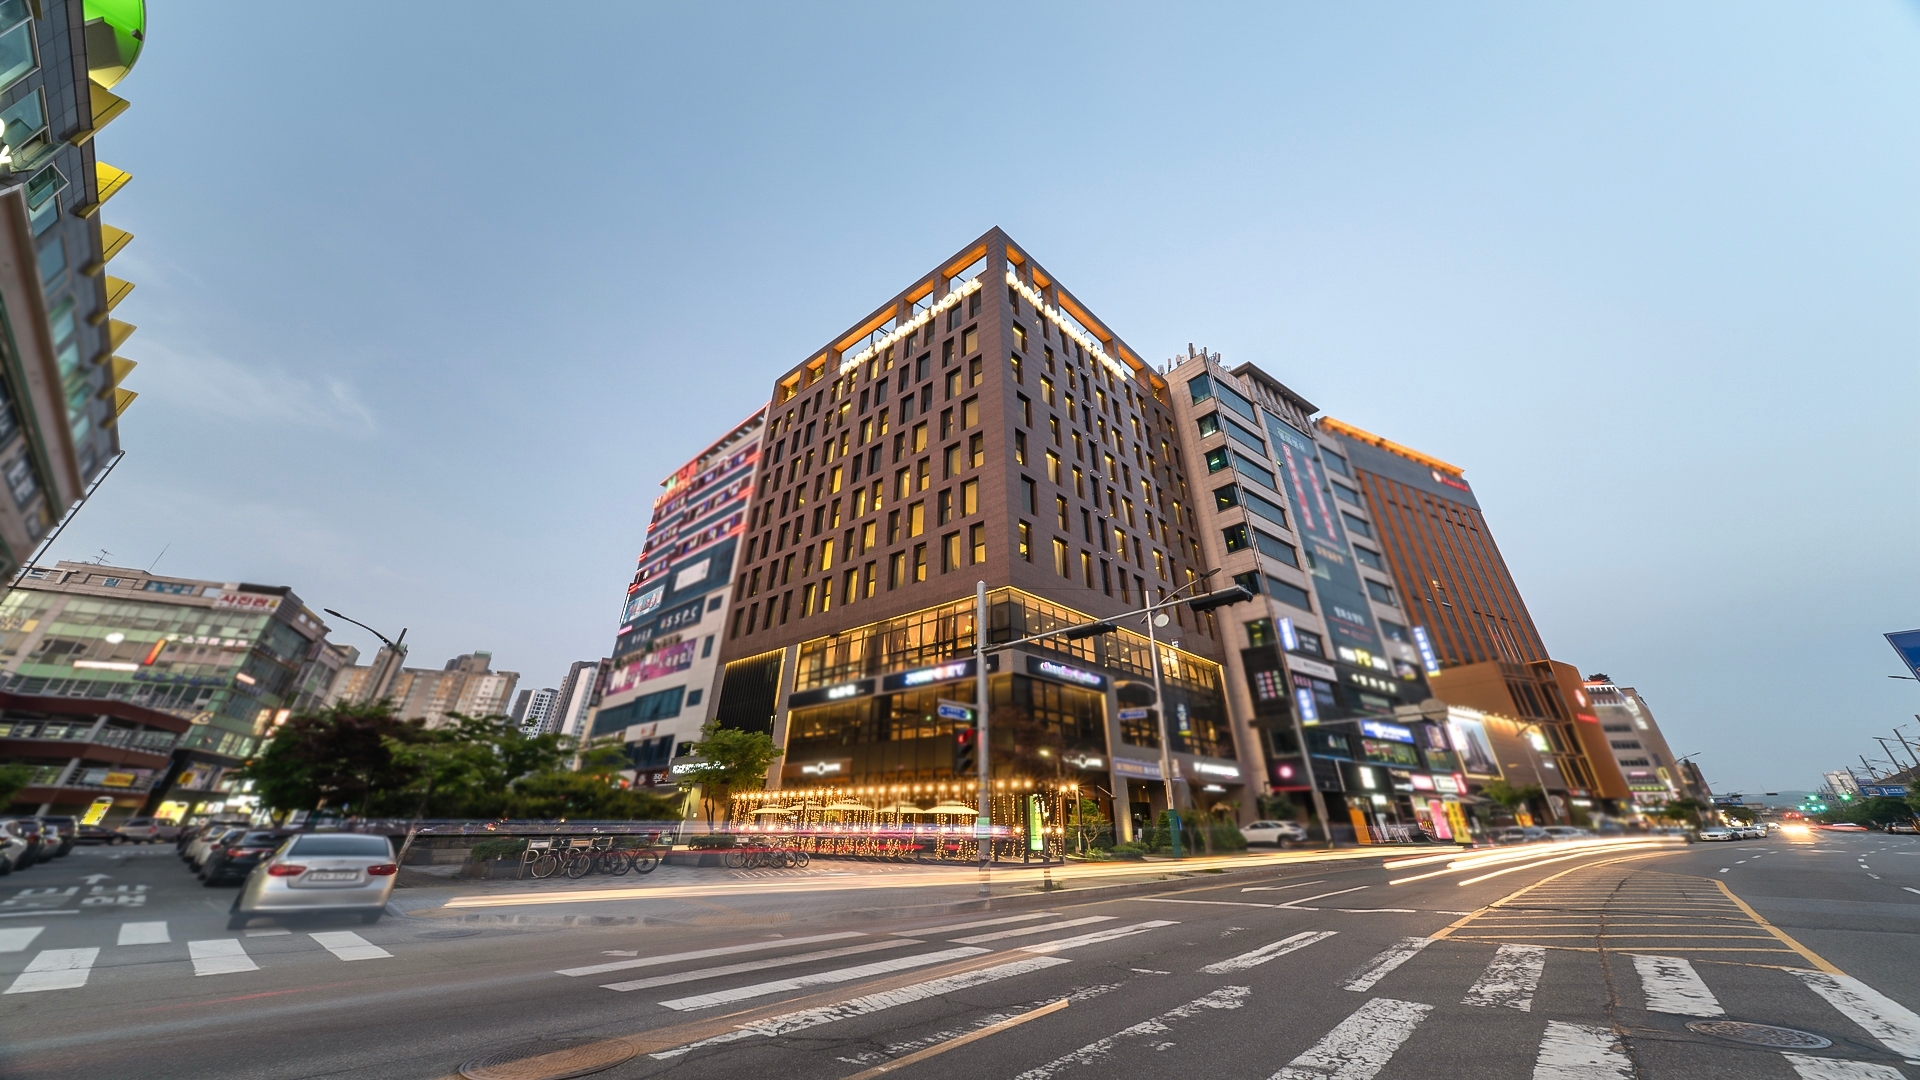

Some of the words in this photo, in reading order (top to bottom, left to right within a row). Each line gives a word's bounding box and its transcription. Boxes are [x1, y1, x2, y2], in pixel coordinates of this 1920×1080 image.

[1005, 270, 1044, 311] PARK
[838, 343, 876, 376] PARK
[873, 308, 931, 353] MARINE
[930, 277, 983, 317] HOTEL
